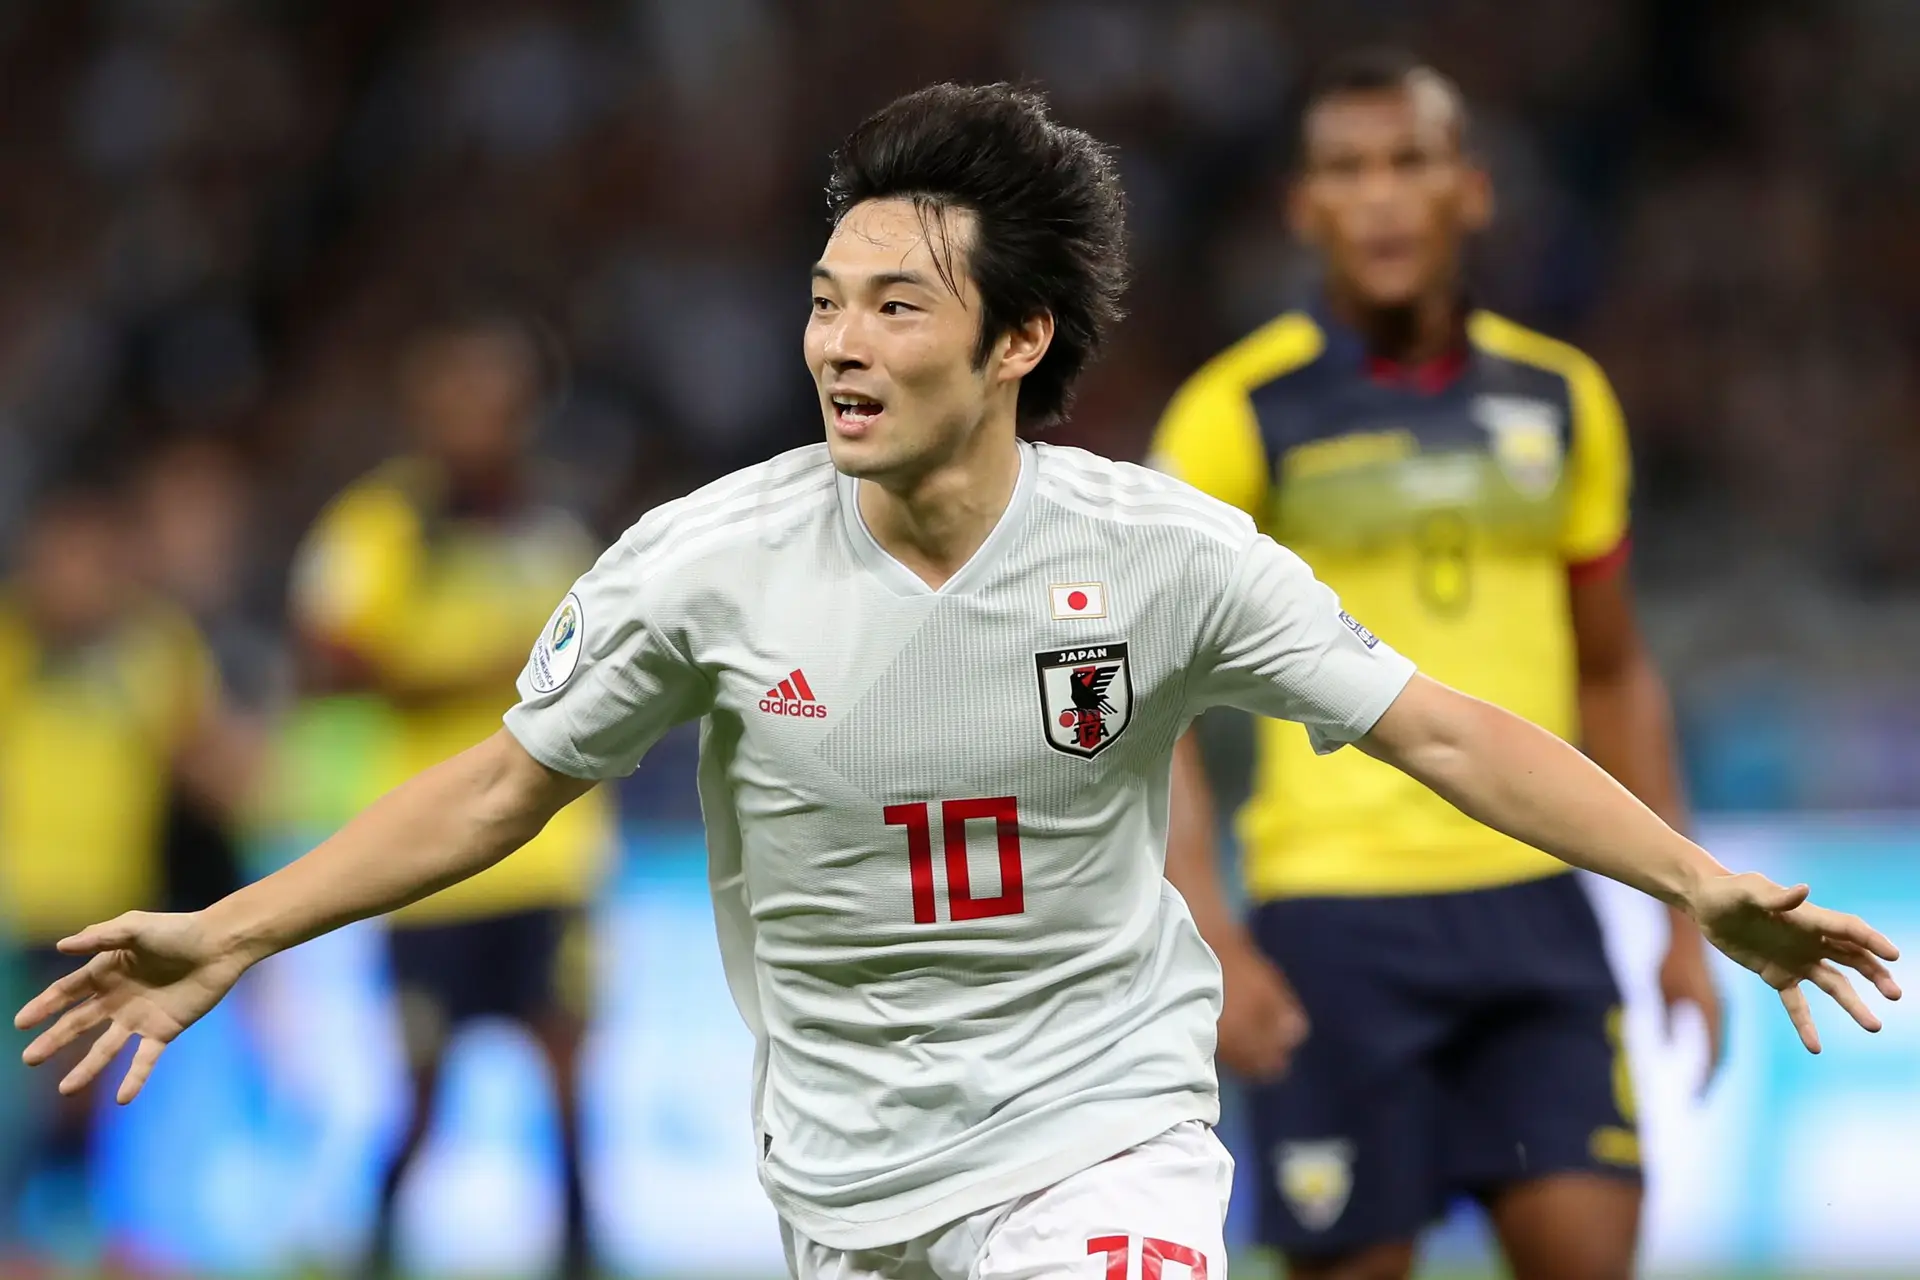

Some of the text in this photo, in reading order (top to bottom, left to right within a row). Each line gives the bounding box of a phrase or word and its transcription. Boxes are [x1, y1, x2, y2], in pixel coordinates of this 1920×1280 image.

[1058, 648, 1107, 662] JAPAN
[759, 698, 827, 718] adidas
[1070, 722, 1109, 744] JFA
[883, 796, 1024, 924] 10
